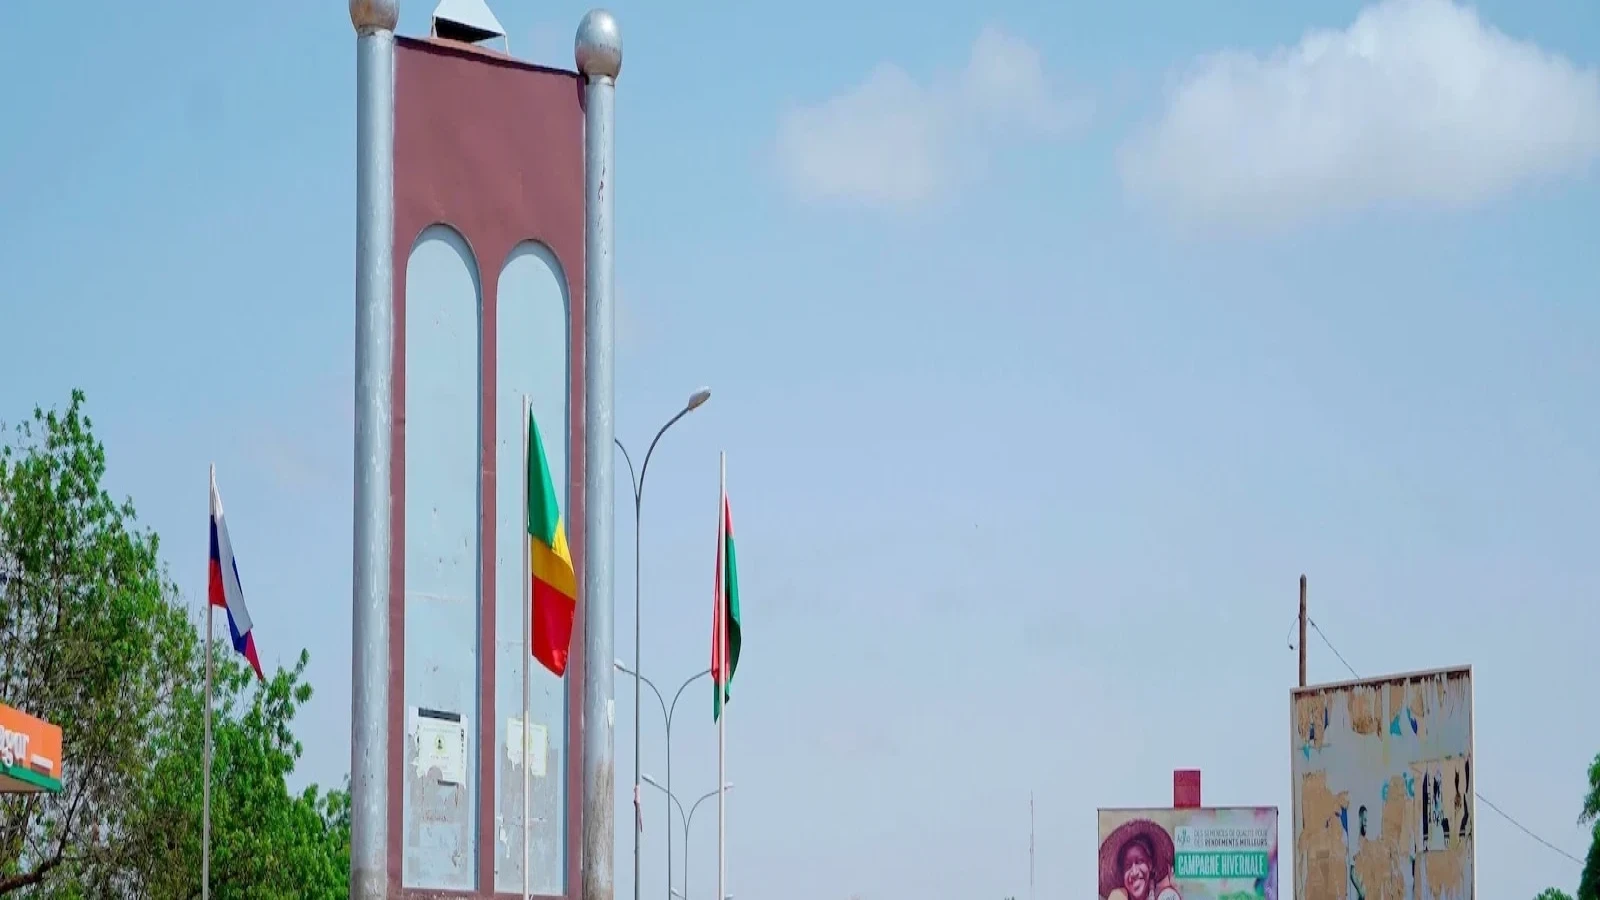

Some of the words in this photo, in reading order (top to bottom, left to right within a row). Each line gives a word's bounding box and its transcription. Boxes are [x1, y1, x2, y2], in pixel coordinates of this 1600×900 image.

[1204, 839, 1239, 847] RENDEMENTS
[1239, 839, 1268, 847] MEILLEURS
[1178, 854, 1220, 876] CAMPAGNE
[1221, 854, 1265, 876] HIVERNALE
